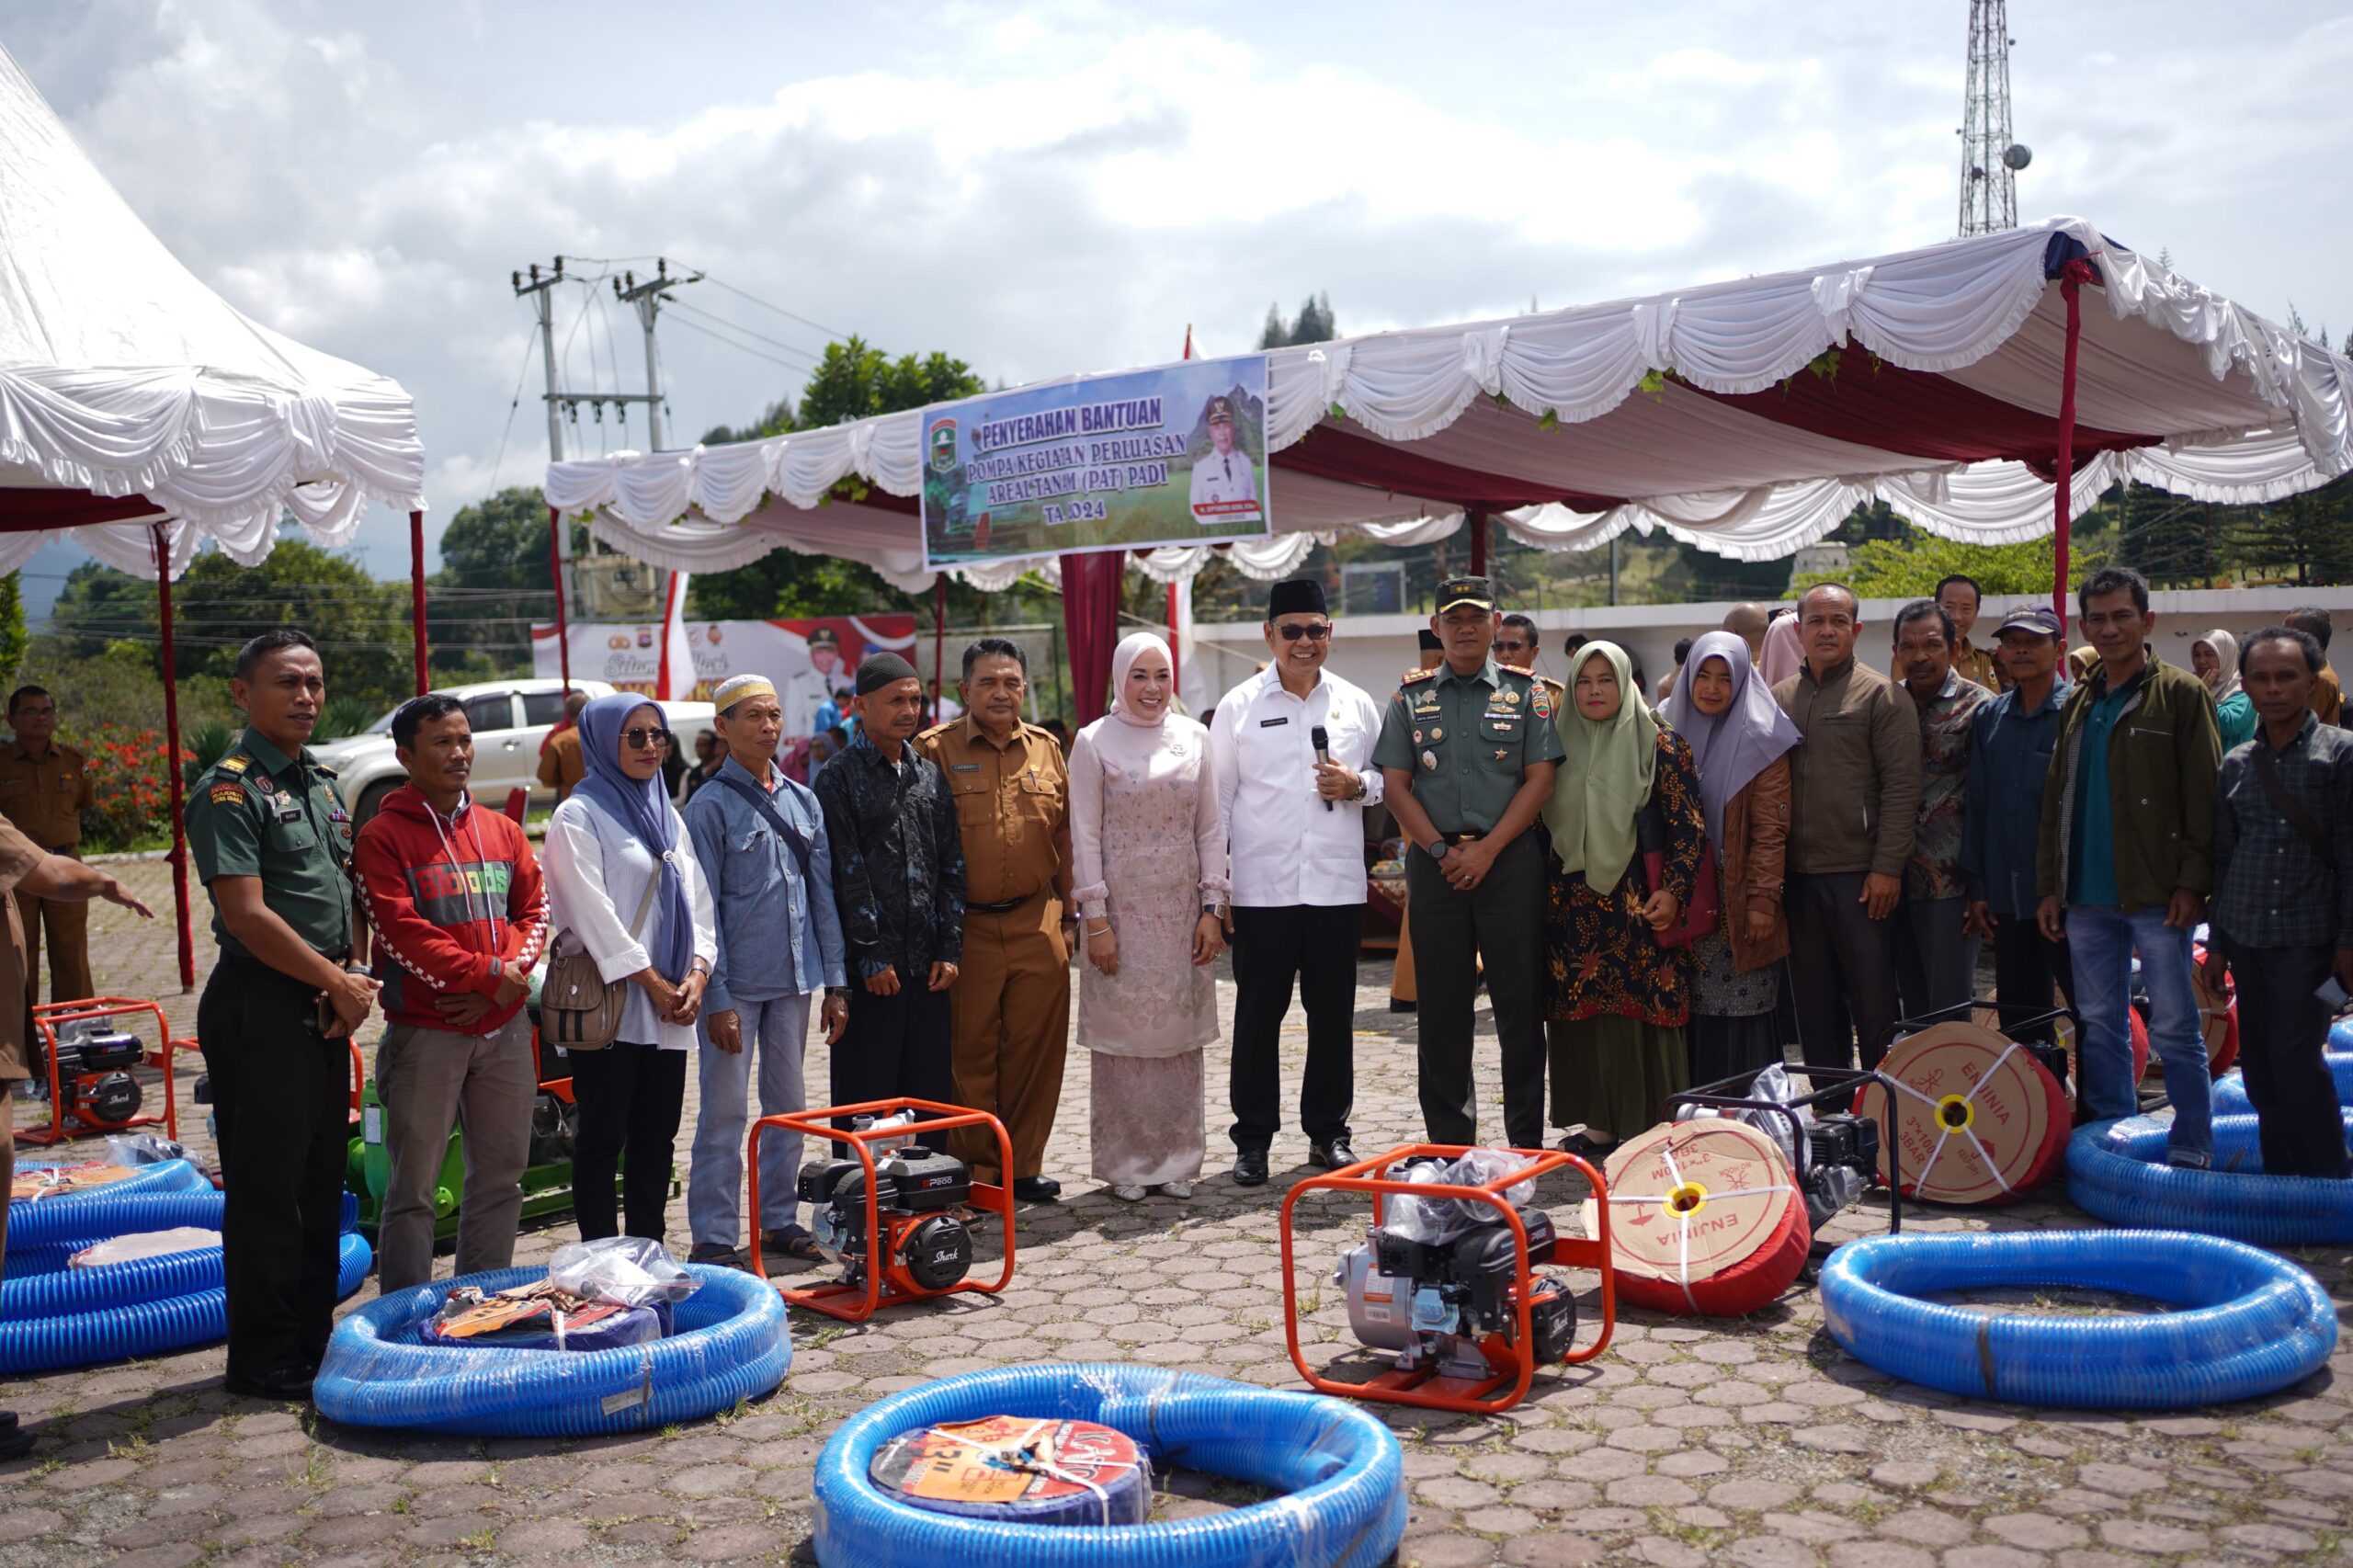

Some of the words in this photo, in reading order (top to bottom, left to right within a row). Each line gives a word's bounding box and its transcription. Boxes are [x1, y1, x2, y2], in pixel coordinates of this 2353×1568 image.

[983, 408, 1076, 449] PENYERAHAN
[1081, 397, 1162, 432] BANTUAN
[968, 457, 1014, 482] POMPA
[1017, 445, 1085, 473] KEGIATAN
[1091, 434, 1186, 462] PERLUASAN
[988, 481, 1032, 504] AREAL
[1082, 468, 1124, 493] (PAT)
[1128, 463, 1167, 486] PADI
[415, 861, 508, 901] Bloods
[1961, 1061, 2010, 1126] ENJINIA
[1899, 1131, 1927, 1165] 3BAR
[932, 1246, 959, 1264] Shark
